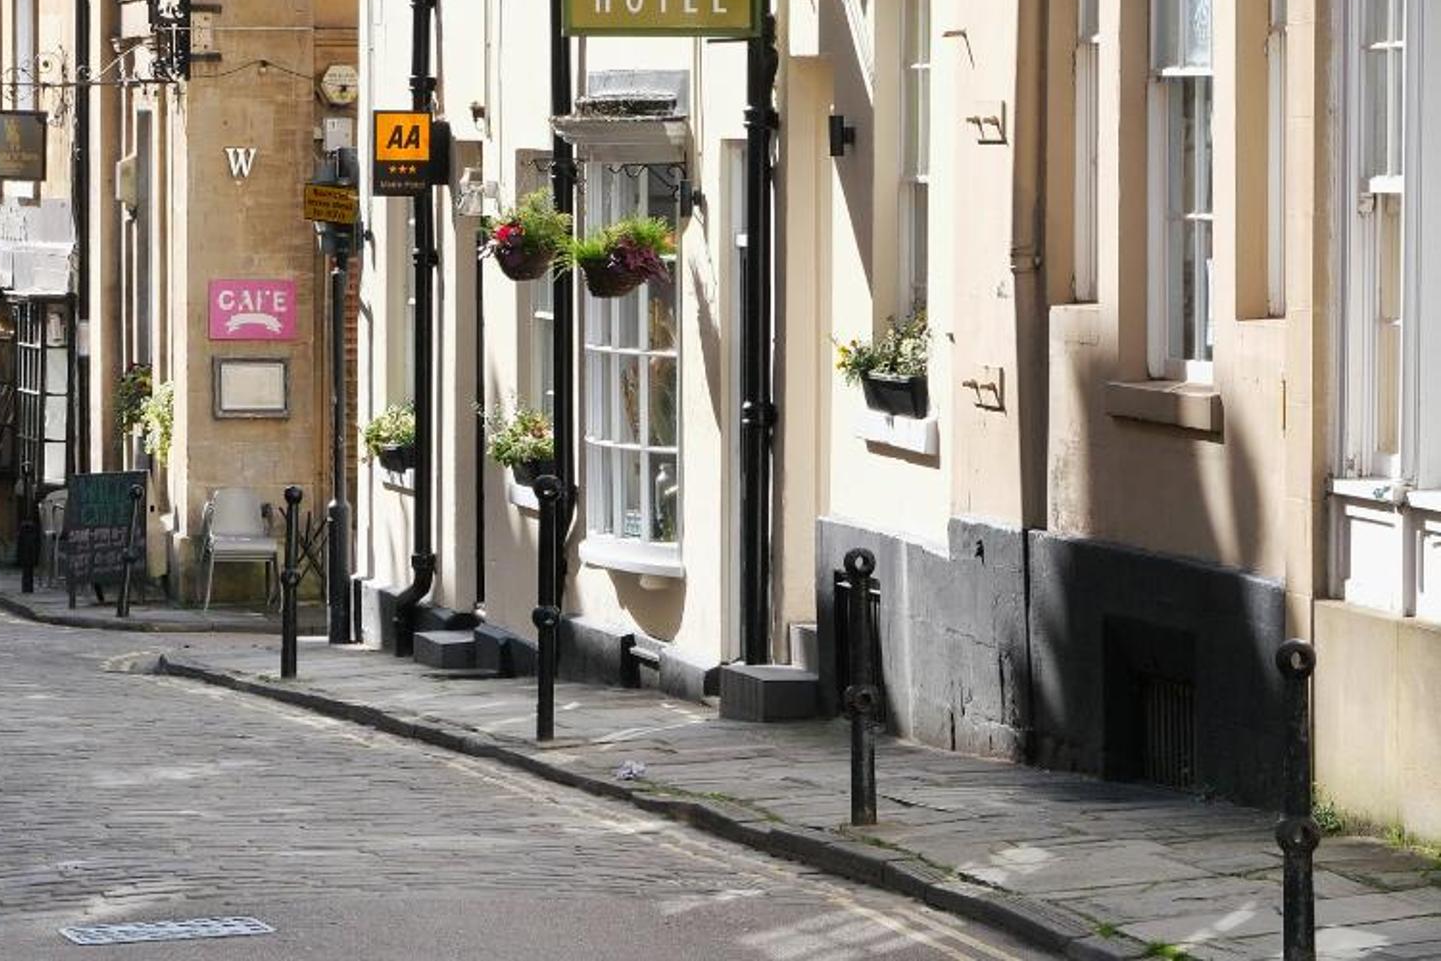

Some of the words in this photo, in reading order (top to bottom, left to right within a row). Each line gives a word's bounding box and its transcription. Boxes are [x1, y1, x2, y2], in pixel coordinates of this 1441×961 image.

[386, 124, 420, 149] AA
[224, 147, 257, 178] W
[218, 289, 287, 312] CAFE
